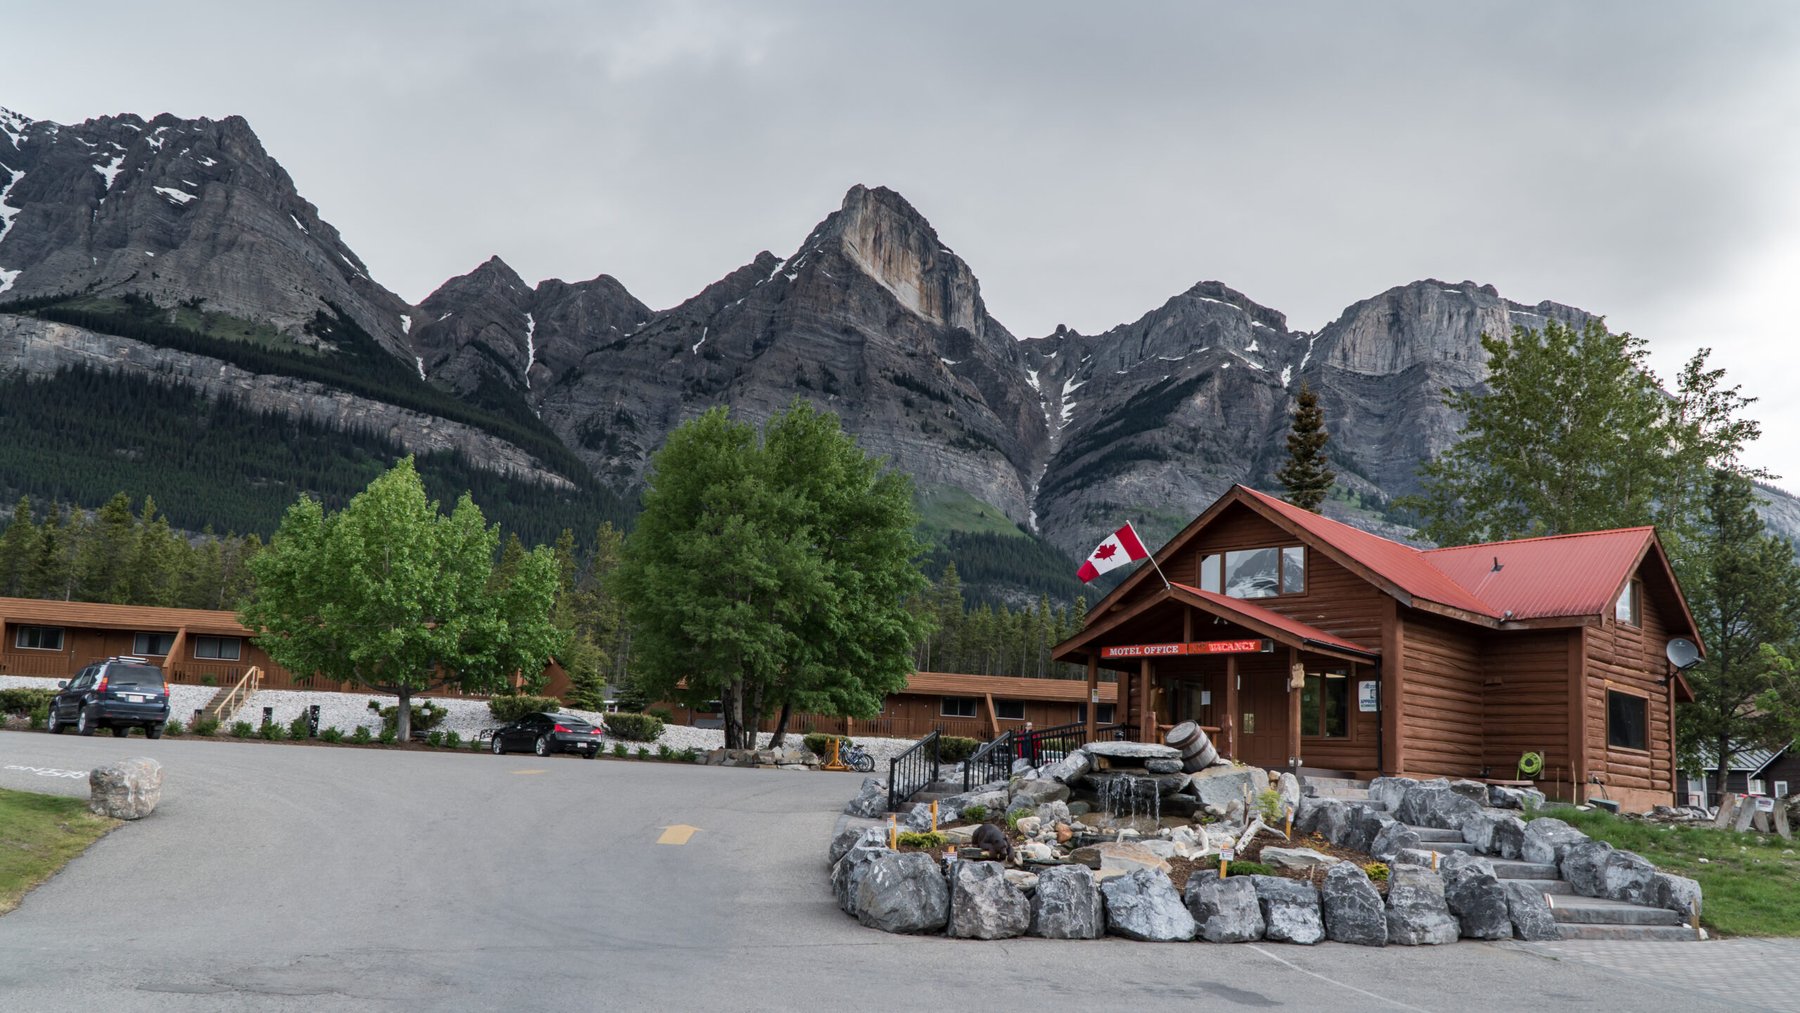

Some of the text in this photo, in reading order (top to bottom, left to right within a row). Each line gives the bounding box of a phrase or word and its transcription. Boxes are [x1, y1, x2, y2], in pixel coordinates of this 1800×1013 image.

[1109, 645, 1179, 656] MOTEL OFFICE
[1209, 641, 1256, 652] VACANCY
